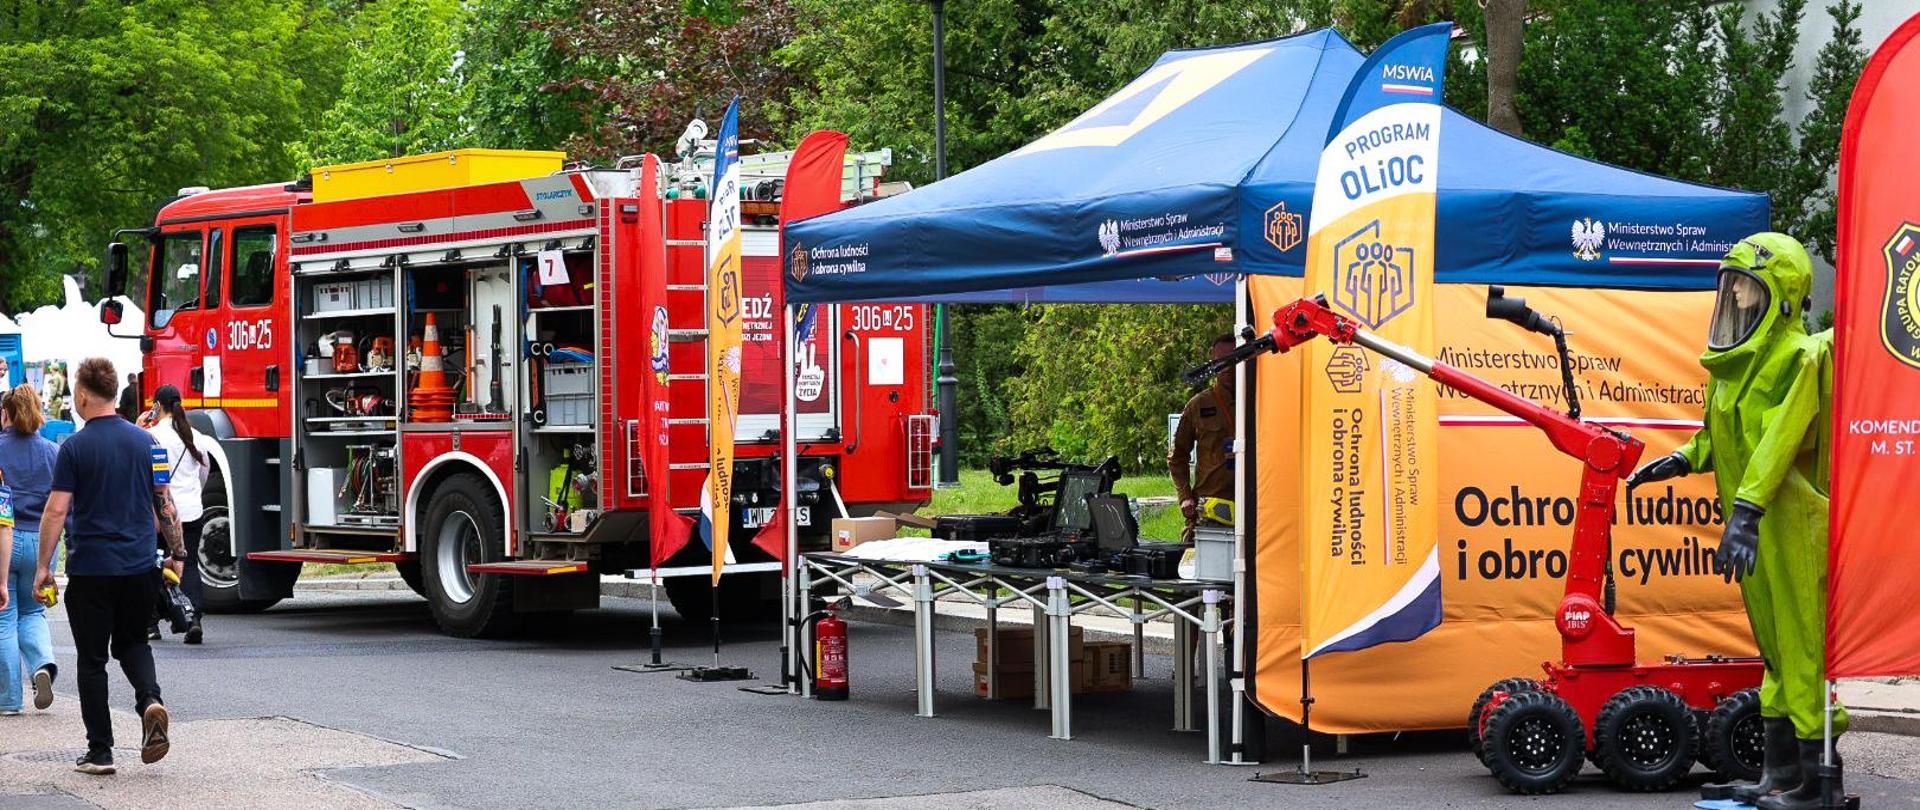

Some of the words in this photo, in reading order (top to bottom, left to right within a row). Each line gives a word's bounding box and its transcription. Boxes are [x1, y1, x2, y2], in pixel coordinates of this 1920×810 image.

[1382, 64, 1434, 82] MSWiA
[1345, 122, 1430, 160] PROGRAM
[1340, 154, 1424, 200] OLiOC
[1120, 215, 1165, 232] Ministerstwo
[1165, 213, 1188, 228] Spraw
[1122, 230, 1173, 248] Wewnętrznych
[1177, 221, 1224, 239] Administracji
[1608, 222, 1675, 236] Ministerstwo
[1676, 223, 1707, 238] Spraw
[811, 246, 839, 260] Ochrona
[840, 242, 869, 258] ludności
[1608, 238, 1683, 253] Wewnętrznych
[1686, 240, 1690, 251] i
[544, 259, 554, 277] 7
[815, 261, 839, 275] obrona
[840, 259, 866, 276] cywilna
[742, 292, 773, 319] EDŹ
[851, 305, 881, 331] 306
[893, 305, 914, 331] 25
[227, 320, 248, 350] 306
[257, 319, 272, 350] 25
[1896, 299, 1920, 343] GRUPA
[1568, 350, 1621, 375] Spraw
[1586, 380, 1594, 400] i
[1600, 380, 1707, 408] Administracj
[1391, 387, 1403, 478] Wewnętrznych
[1406, 388, 1417, 465] Ministerstwo
[1333, 418, 1348, 483] obrona
[1350, 408, 1363, 486] Ochrona
[1871, 440, 1890, 455] M.
[1895, 440, 1916, 455] ST.
[1408, 469, 1419, 506] Spraw
[1455, 486, 1618, 527] Ochro
[1331, 487, 1346, 557] cywilna
[1350, 490, 1365, 565] ludności
[1394, 488, 1407, 565] Administracji
[1458, 539, 1467, 580] i
[1478, 538, 1568, 580] obro
[1619, 537, 1723, 585] cywiln
[1565, 610, 1591, 621] PIAP
